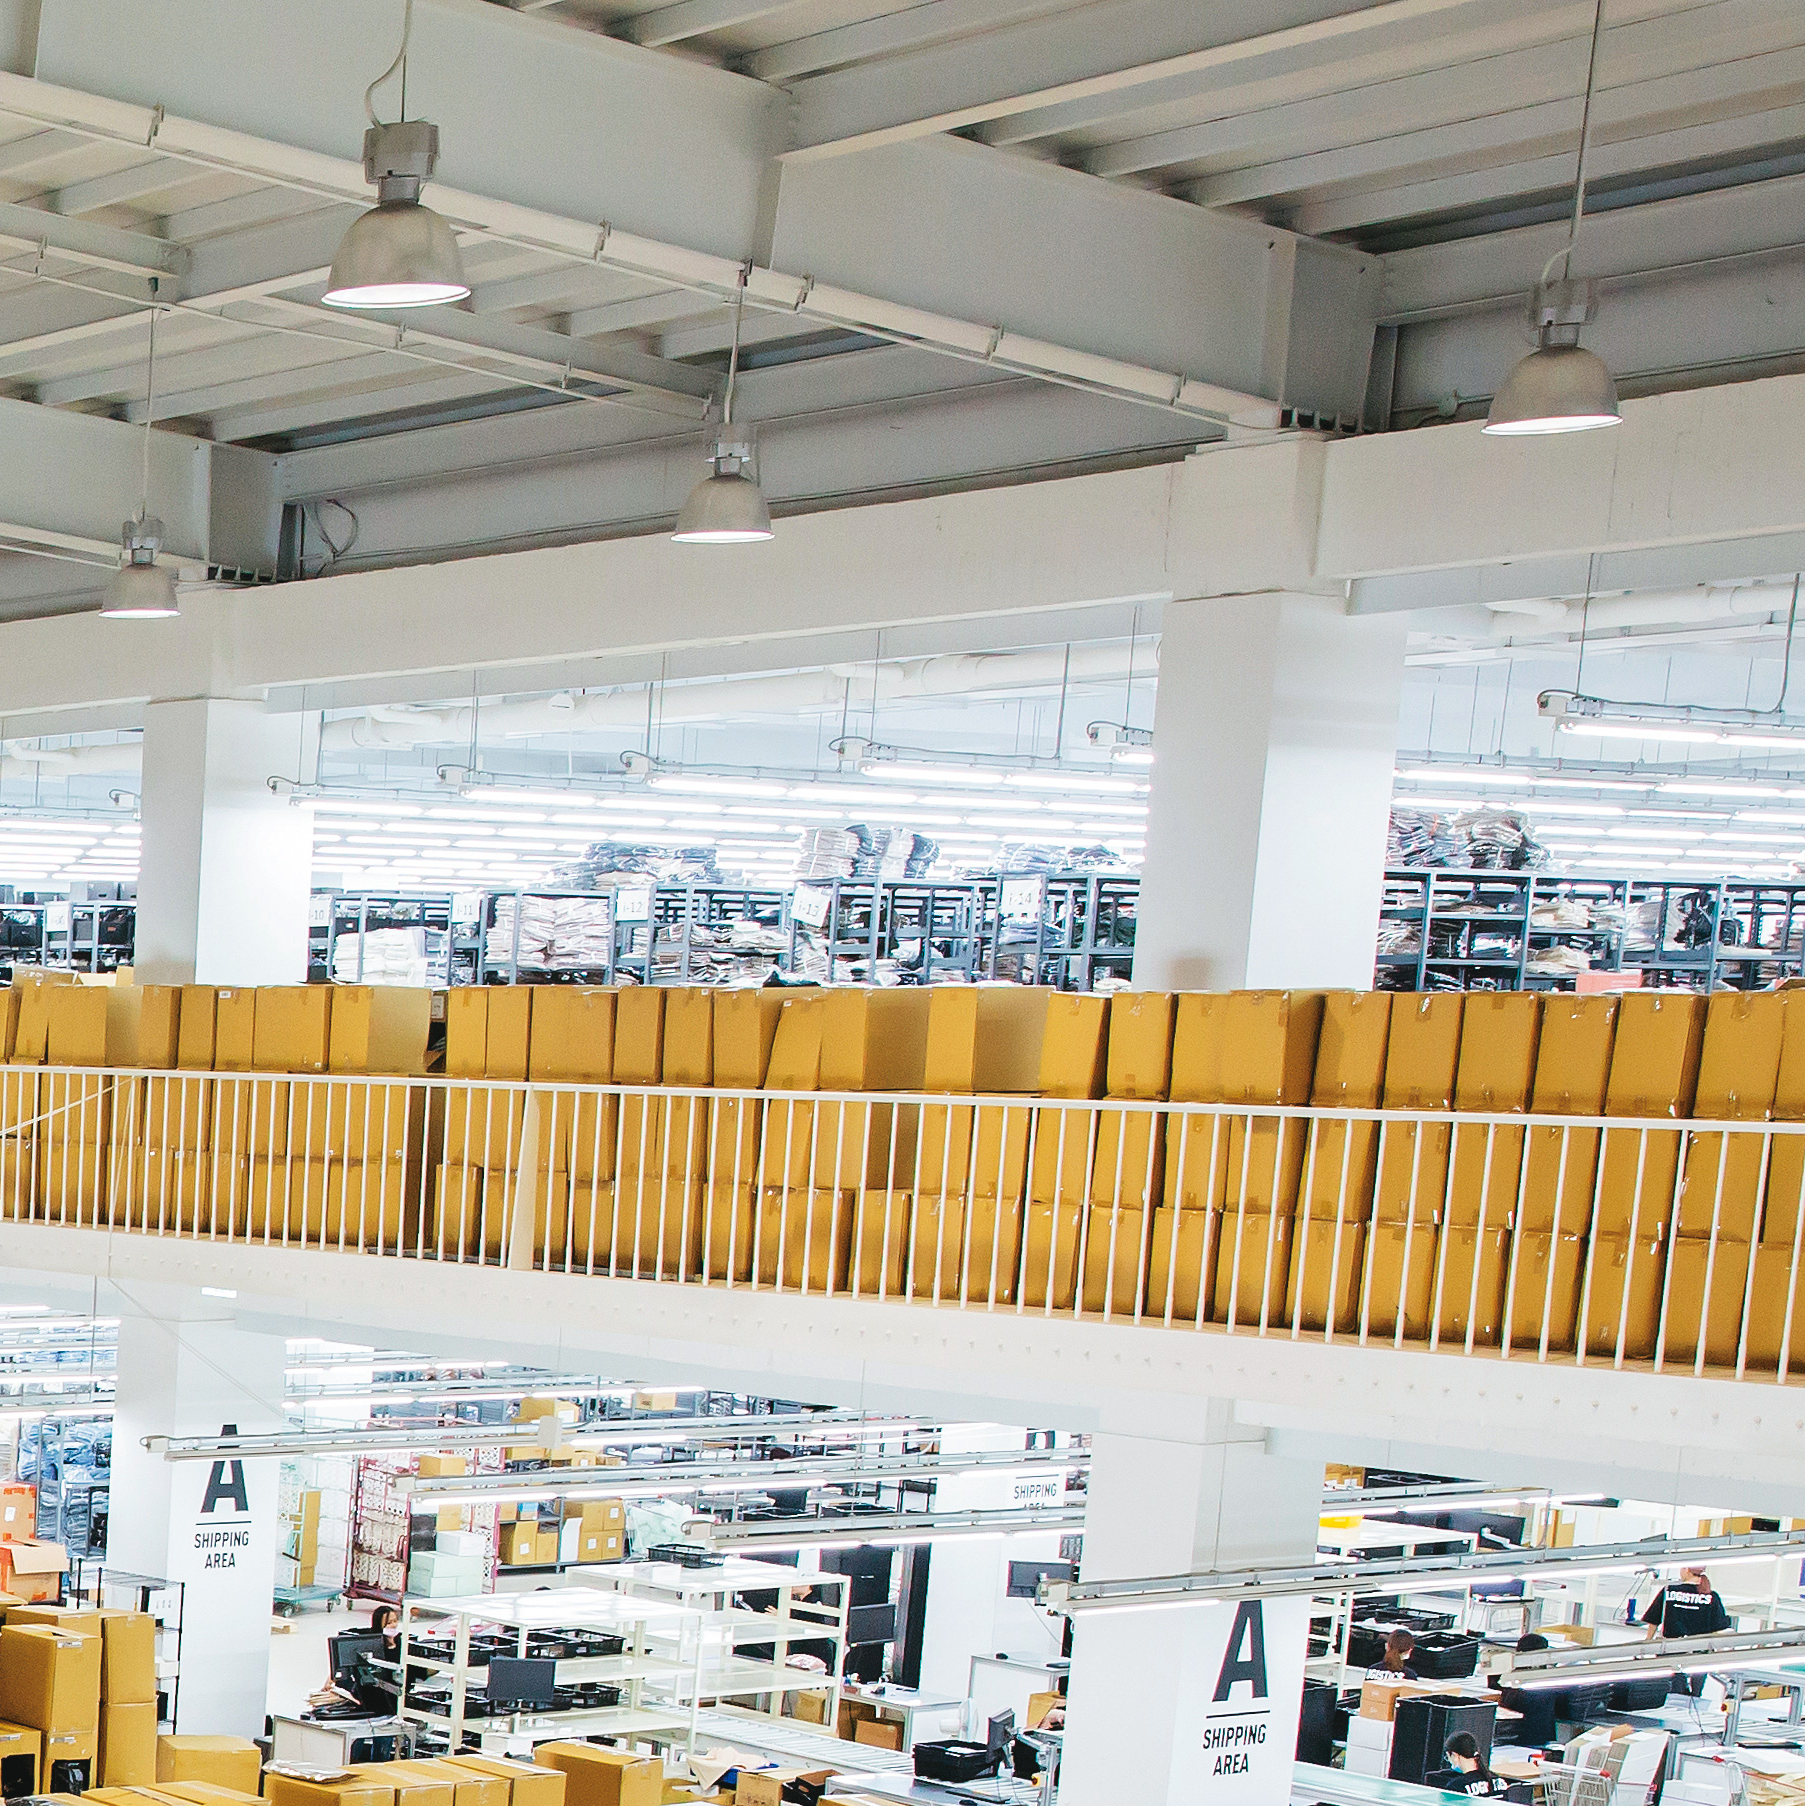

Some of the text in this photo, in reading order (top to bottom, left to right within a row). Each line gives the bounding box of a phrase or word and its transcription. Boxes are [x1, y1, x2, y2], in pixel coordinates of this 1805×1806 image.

[200, 1424, 249, 1513] A
[1013, 1483, 1057, 1500] SHIPPING
[194, 1531, 249, 1549] SHIPPING
[204, 1552, 236, 1569] AREA
[1665, 1590, 1713, 1605] LOGISTICS
[1212, 1599, 1268, 1702] A
[1202, 1723, 1267, 1749] SHIPPING
[1212, 1753, 1250, 1776] AREA
